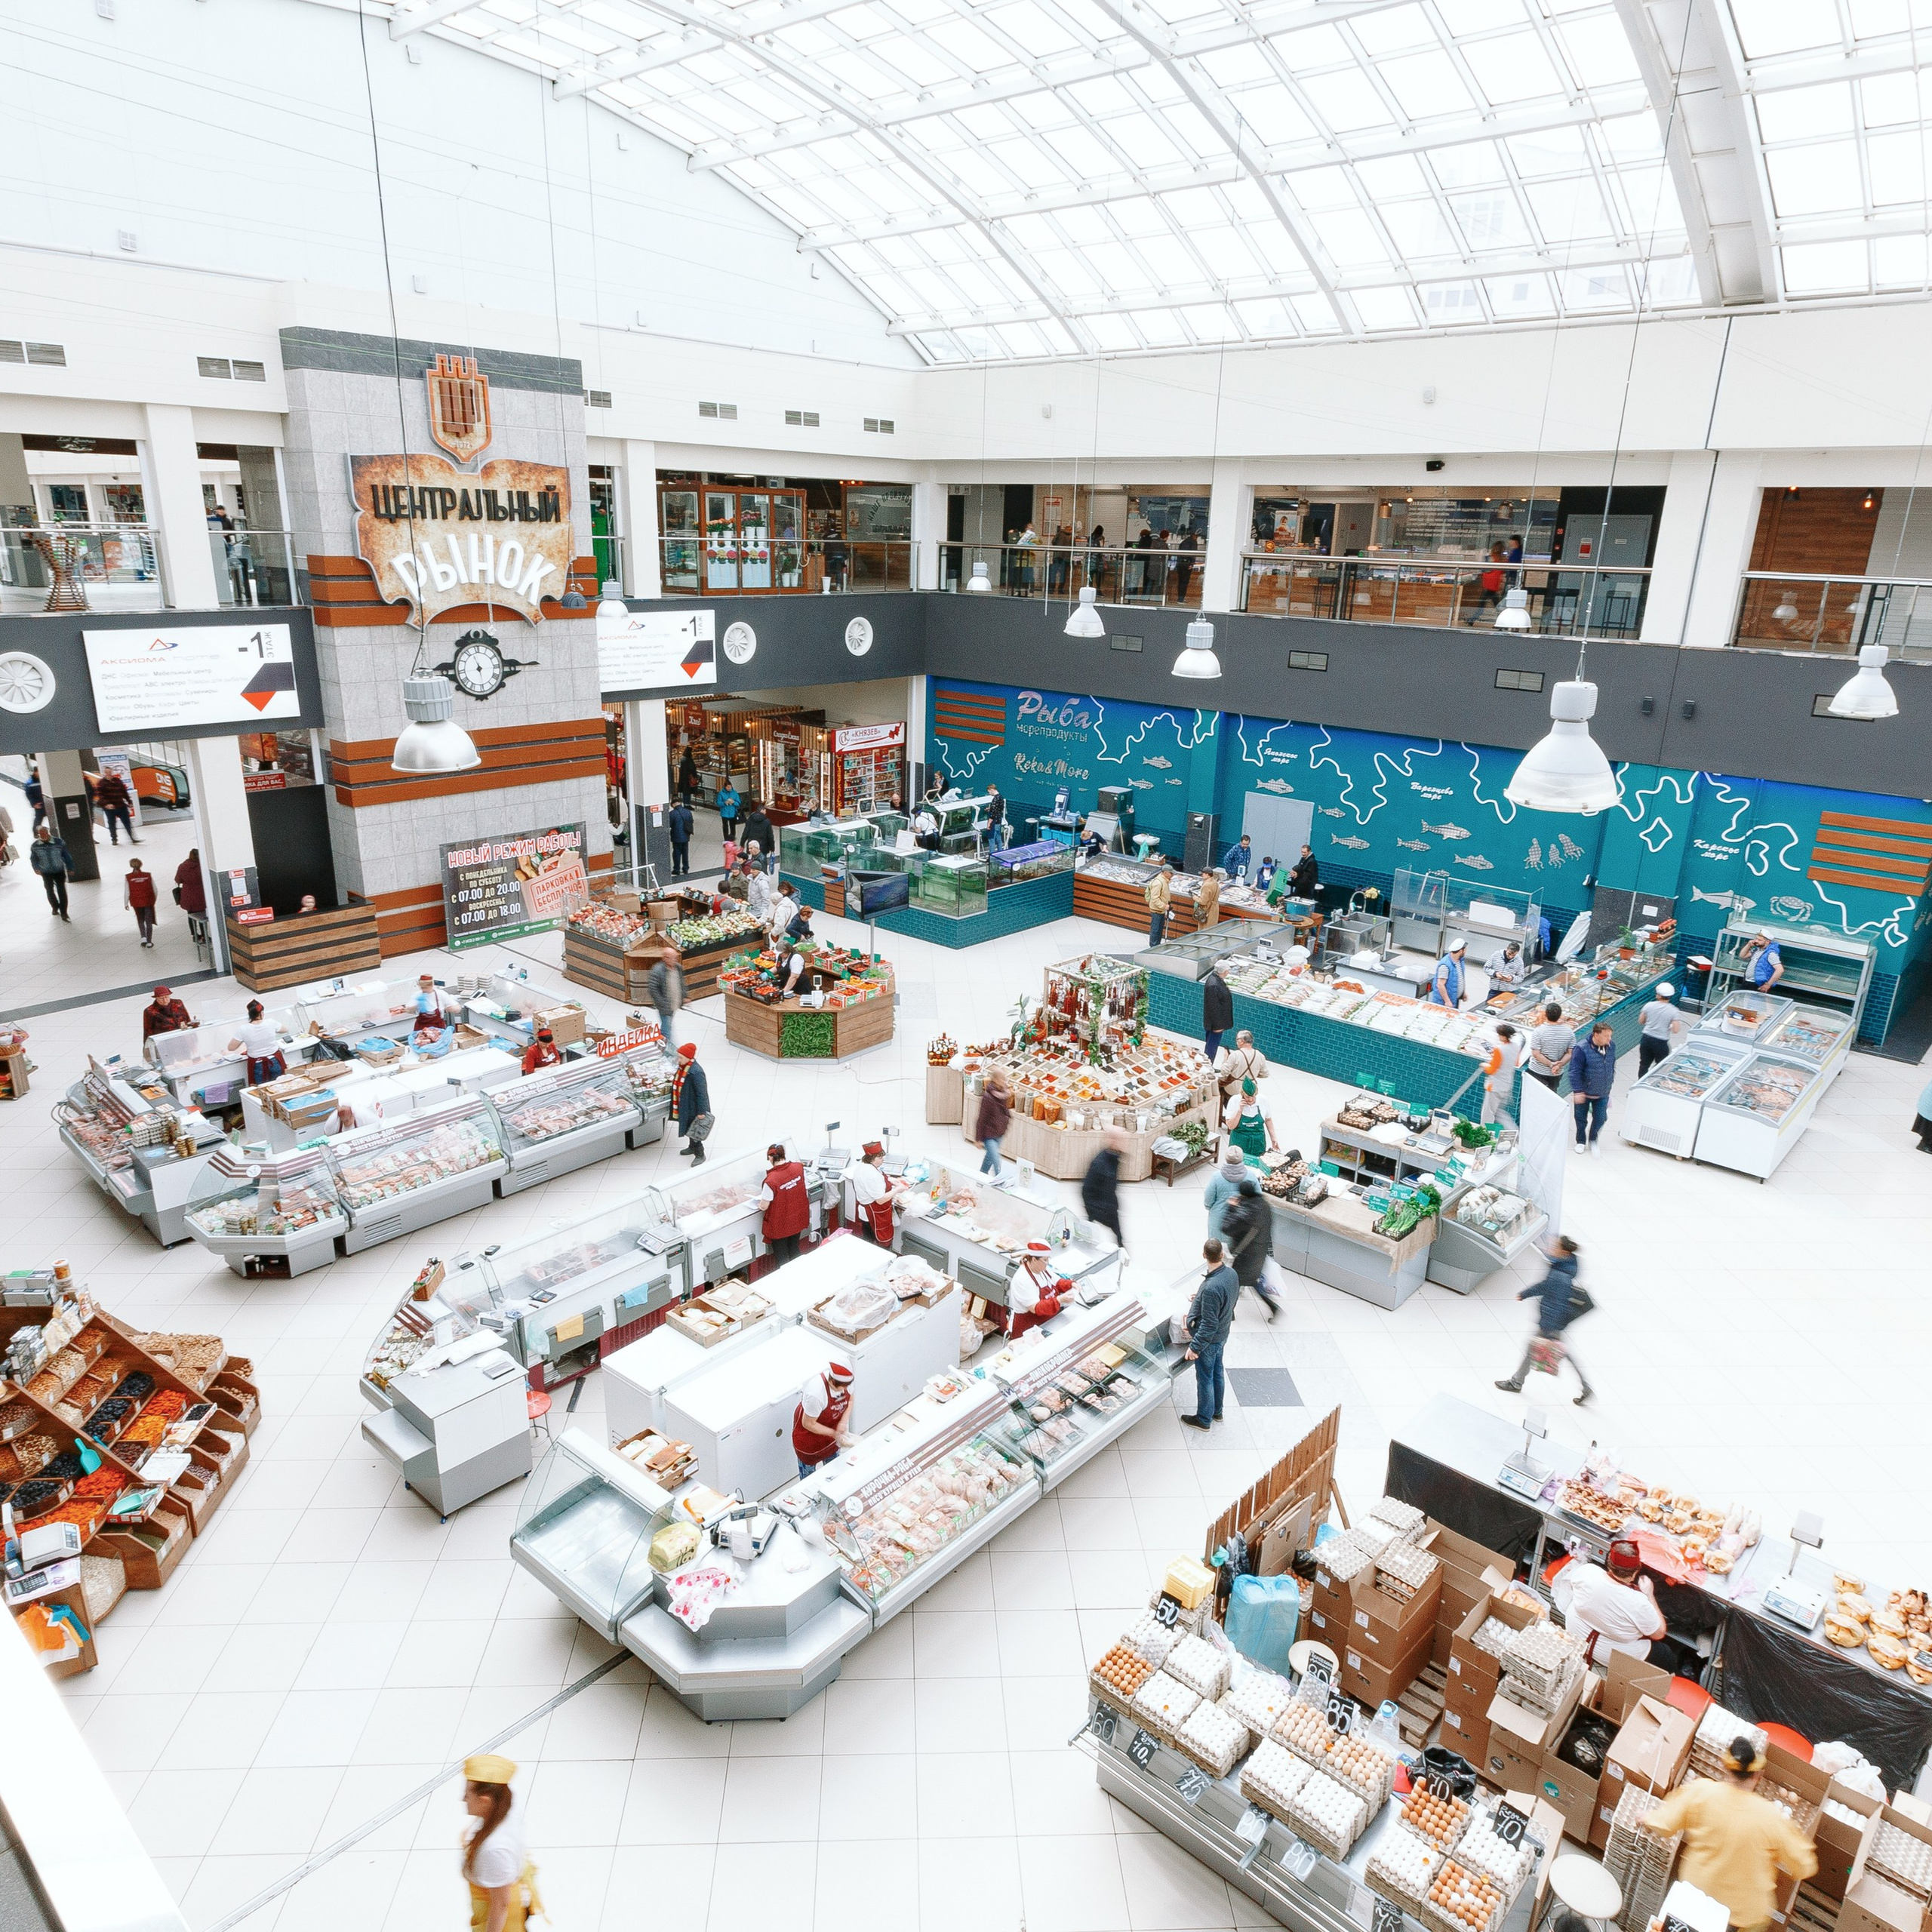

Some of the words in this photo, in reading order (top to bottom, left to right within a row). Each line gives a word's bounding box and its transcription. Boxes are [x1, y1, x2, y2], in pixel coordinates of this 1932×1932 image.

[371, 484, 561, 524] ЦЕНТРАЛЬНЫЙ
[389, 533, 557, 606] РЫНОК
[264, 631, 275, 658] ЭТАЖ
[101, 657, 167, 665] АКСИОМА
[153, 669, 192, 677] Мебельный
[160, 679, 186, 688] электро
[185, 688, 218, 697] Сувениры
[109, 713, 150, 721] Ювелирные
[1017, 691, 1093, 729] Рыба
[1016, 724, 1088, 743] морепродукты
[1263, 747, 1298, 759] Японское
[155, 772, 172, 786] DNS
[1411, 781, 1454, 795] Баренцево
[1420, 792, 1442, 801] море
[448, 842, 492, 869] НОВЫЙ
[493, 838, 537, 860] РЕЖИМ
[537, 831, 581, 853] РАБОТЫ
[1693, 838, 1740, 854] Карское
[1700, 852, 1729, 861] море
[465, 866, 508, 881] ПОНЕДЕЛЬНИКА
[469, 880, 478, 888] ПО
[478, 876, 502, 887] СУББОТУ
[535, 872, 574, 895] ПАРКОВКА
[458, 888, 483, 902] 07.00
[485, 888, 495, 898] ДО
[497, 881, 521, 895] 20.00
[461, 909, 486, 924] 07.00
[488, 909, 498, 920] ДО
[500, 903, 521, 917] 18.00
[468, 897, 506, 911] ВОСКРЕСЕНЬЕ
[860, 1457, 915, 1499] КУРОЧКА-РЯБА
[1155, 1598, 1180, 1625] 50
[1092, 1712, 1115, 1740] 60
[1326, 1698, 1352, 1734] 85
[1178, 1768, 1208, 1801] 75
[1429, 1773, 1450, 1801] 70
[1237, 1810, 1266, 1841] 80
[1495, 1810, 1522, 1841] 70
[1283, 1841, 1316, 1877] 80
